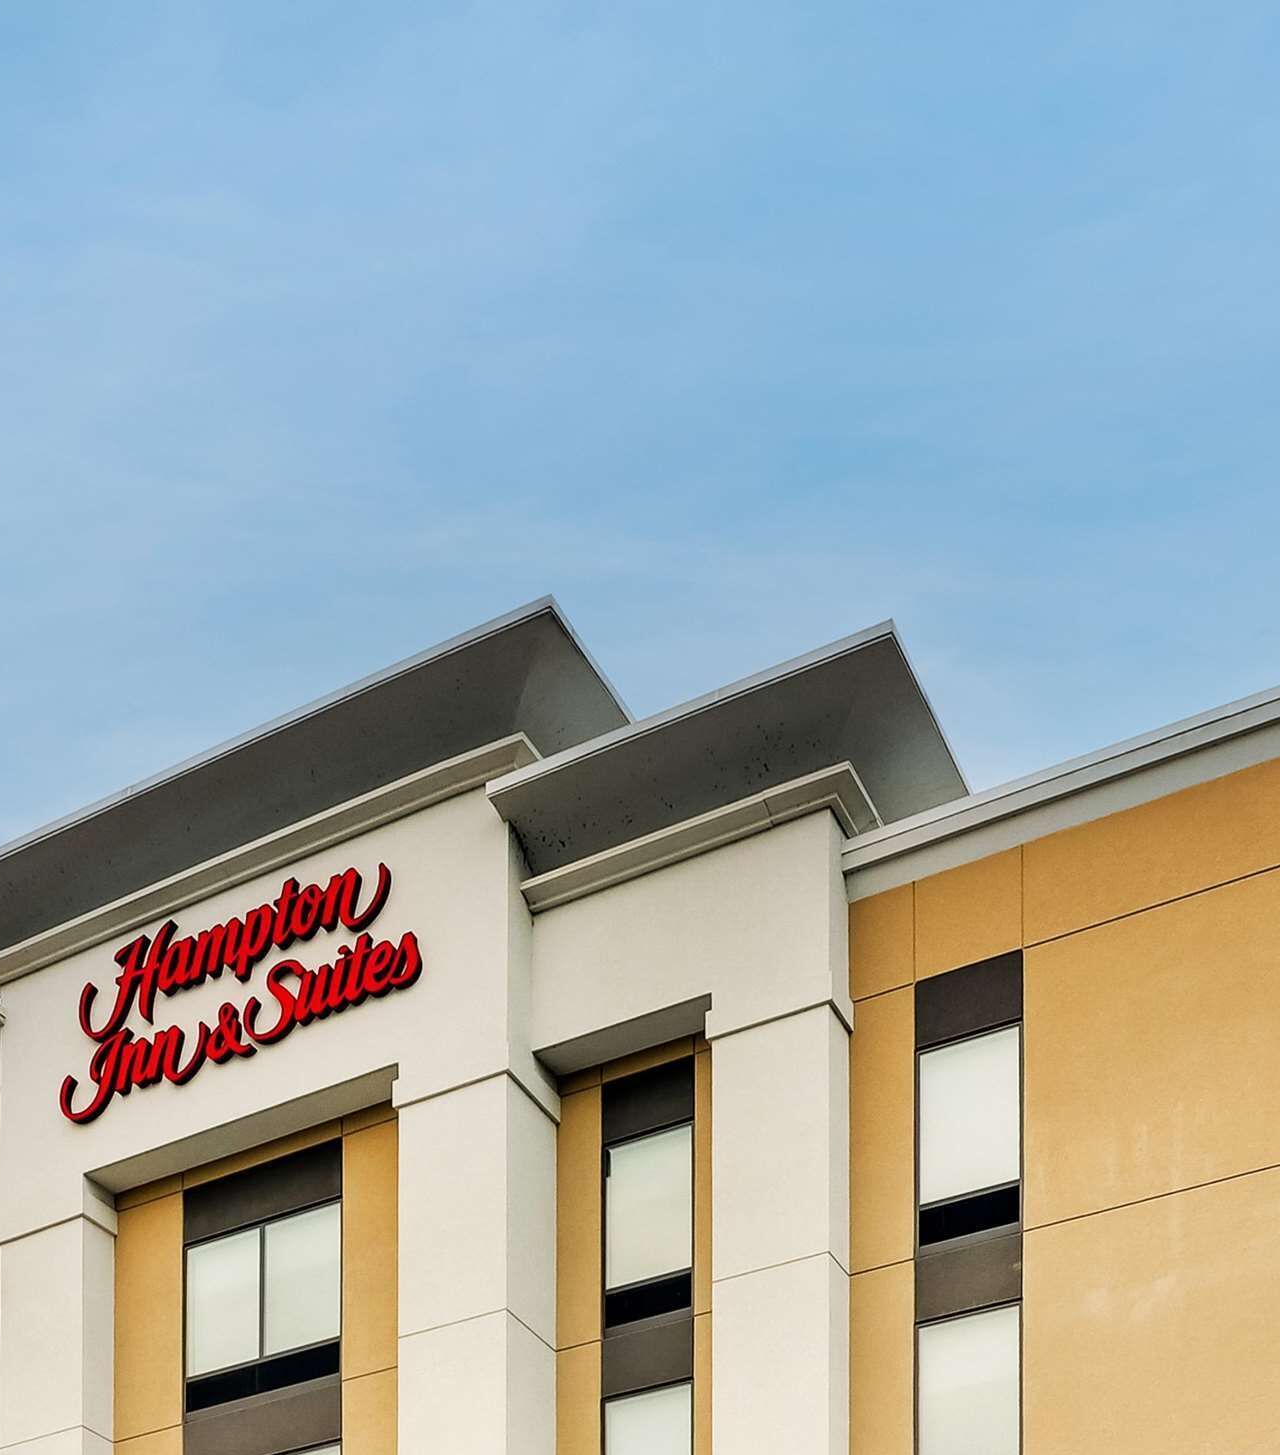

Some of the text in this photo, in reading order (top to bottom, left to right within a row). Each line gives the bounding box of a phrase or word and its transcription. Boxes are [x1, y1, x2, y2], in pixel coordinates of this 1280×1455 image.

[59, 931, 424, 1124] Inn & Suites
[78, 862, 392, 1043] Hampton
